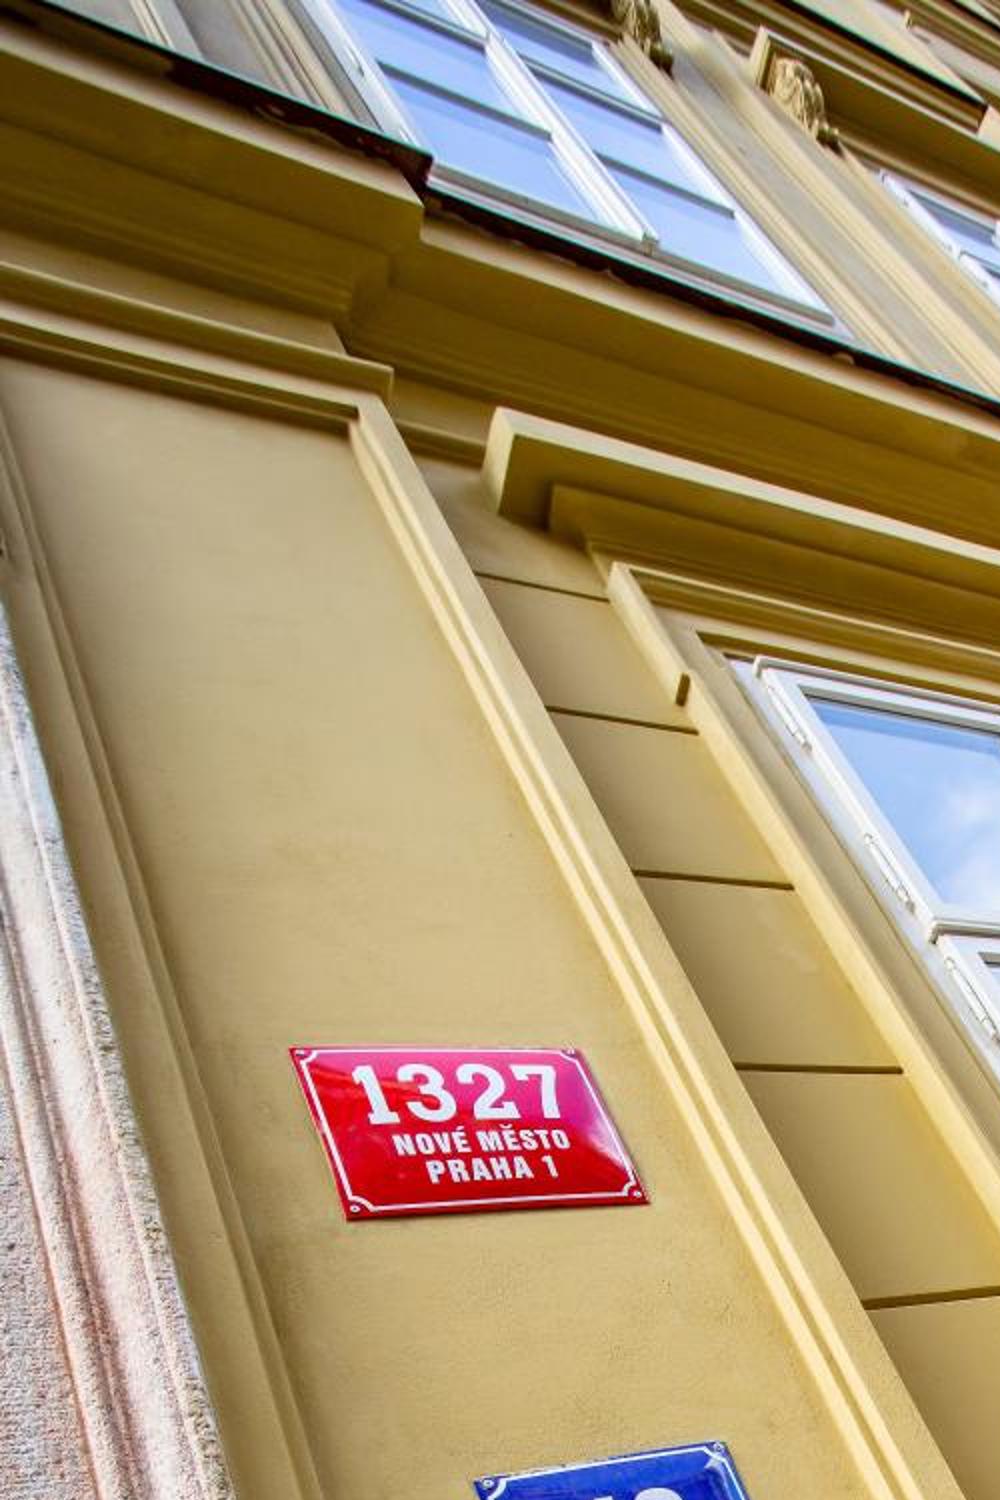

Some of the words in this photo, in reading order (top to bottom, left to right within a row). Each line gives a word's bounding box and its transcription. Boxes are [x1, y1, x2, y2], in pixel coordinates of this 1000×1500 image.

[352, 1064, 560, 1124] 1327
[393, 1125, 471, 1154] NOVÉ
[477, 1123, 570, 1152] MĚSTO
[426, 1157, 533, 1183] PRAHA
[542, 1155, 558, 1178] 1
